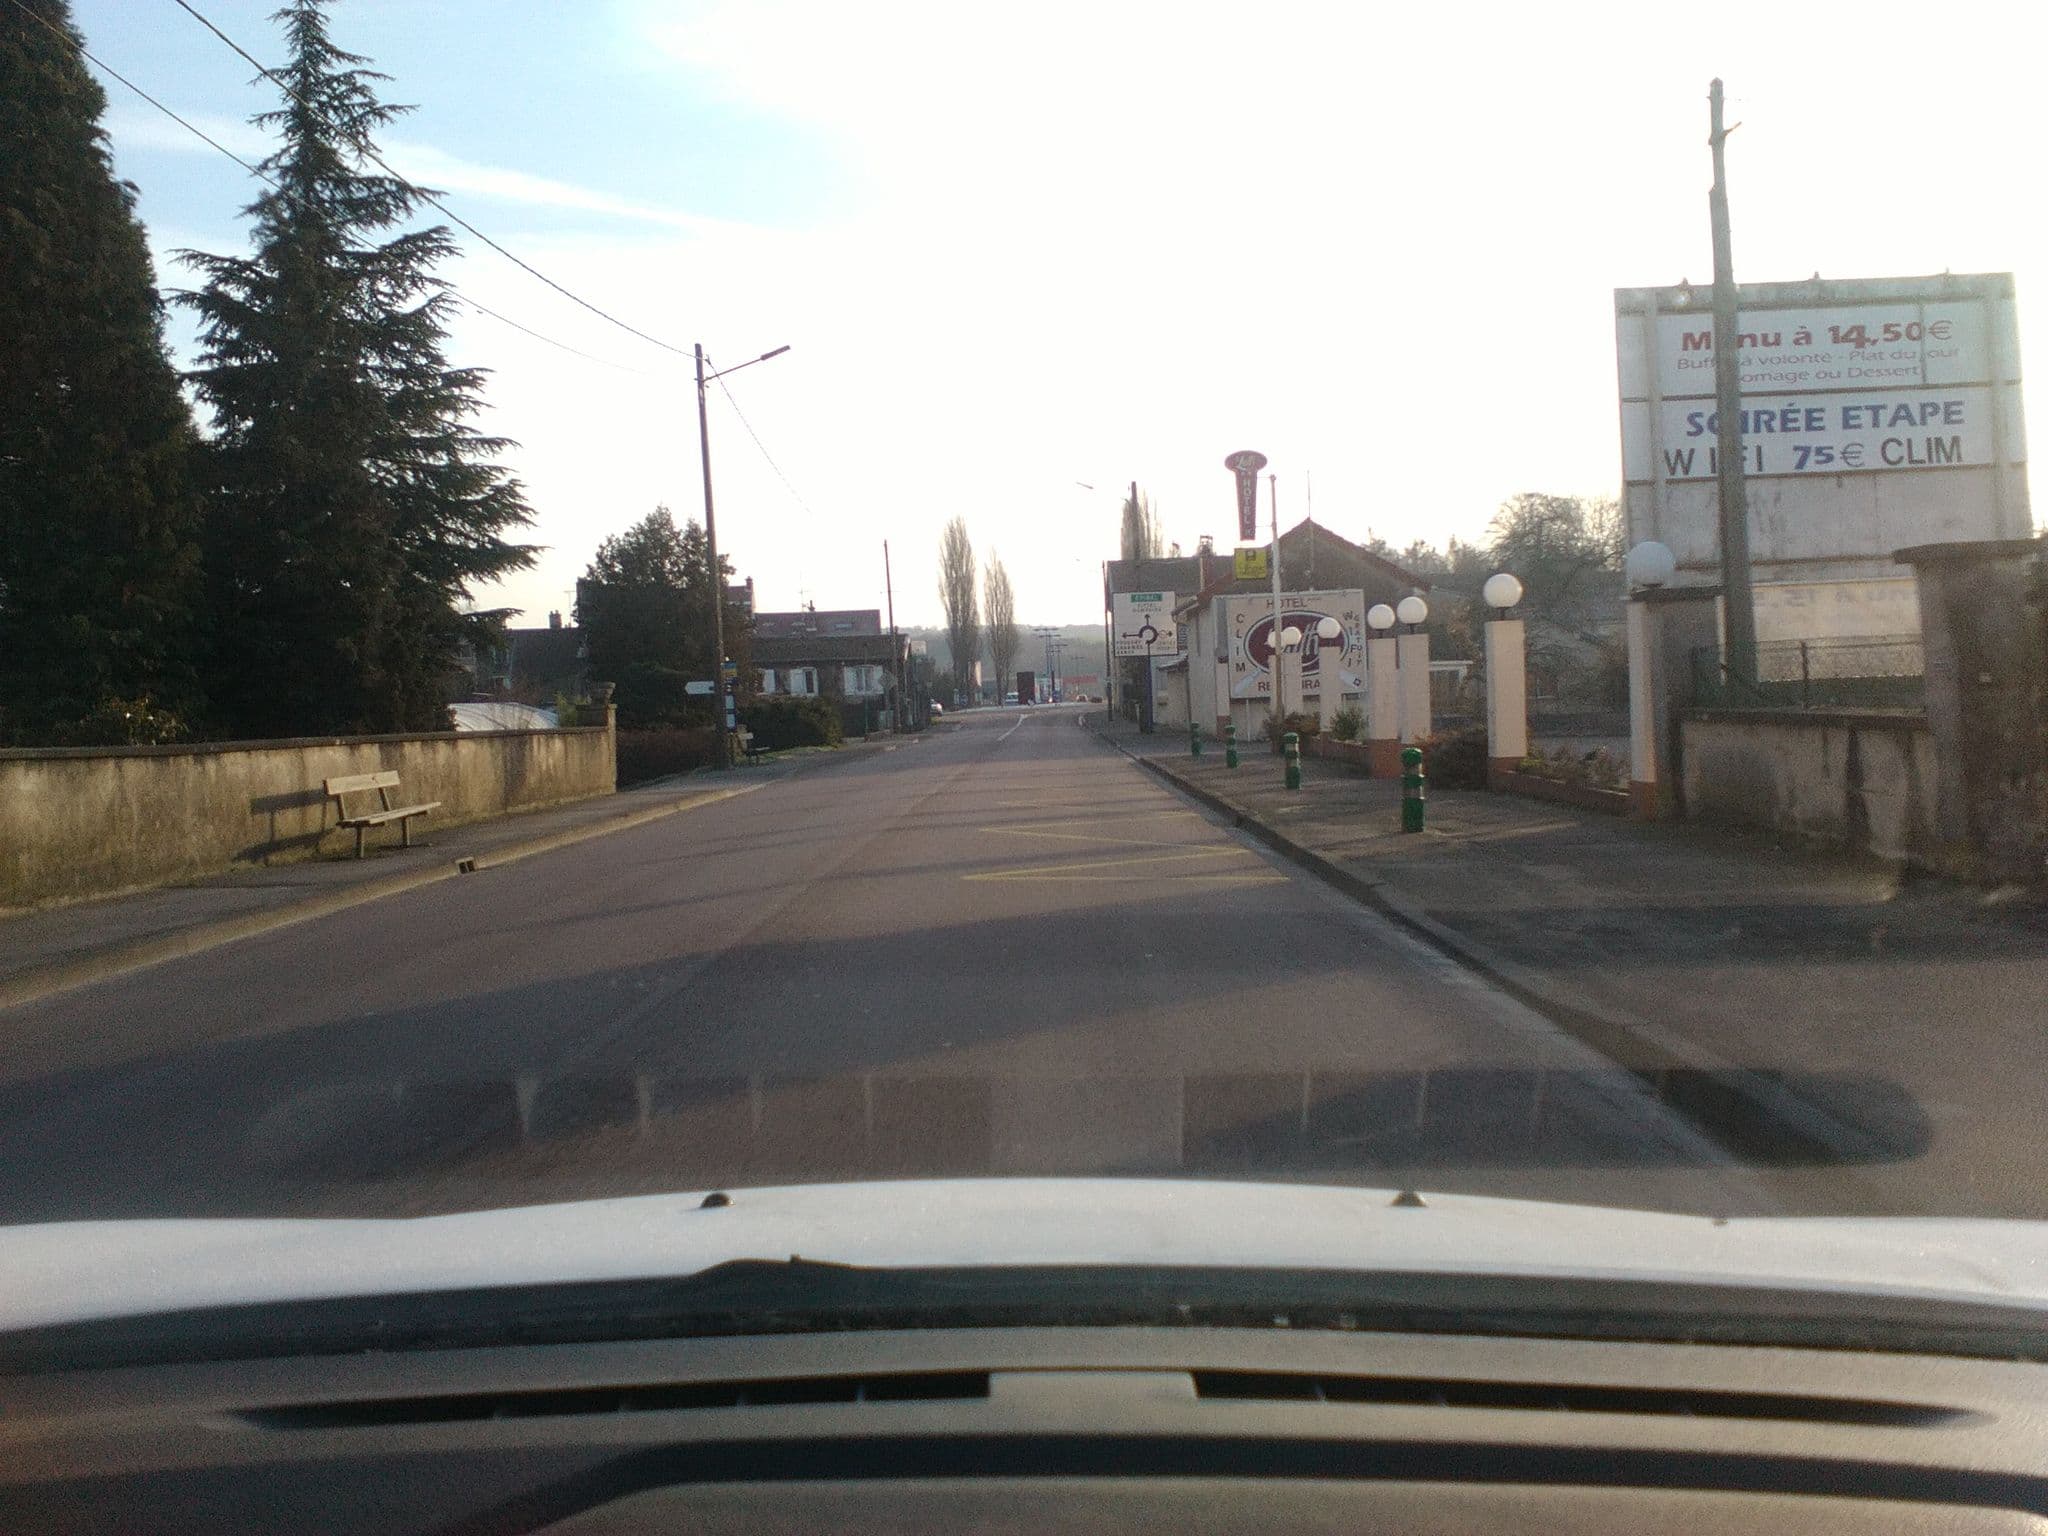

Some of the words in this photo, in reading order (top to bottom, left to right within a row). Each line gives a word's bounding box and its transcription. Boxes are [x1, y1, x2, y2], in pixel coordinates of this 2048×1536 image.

[1681, 328, 1782, 351] Mnu
[1793, 325, 1812, 346] à
[1849, 349, 1885, 363] Plat
[1889, 348, 1917, 361] du
[1736, 368, 1811, 386] omage
[1816, 369, 1842, 381] ou
[1848, 365, 1921, 380] Dessert
[1841, 400, 1967, 431] ETAPE
[1792, 441, 1866, 471] 75€
[1881, 434, 1964, 467] CLIM
